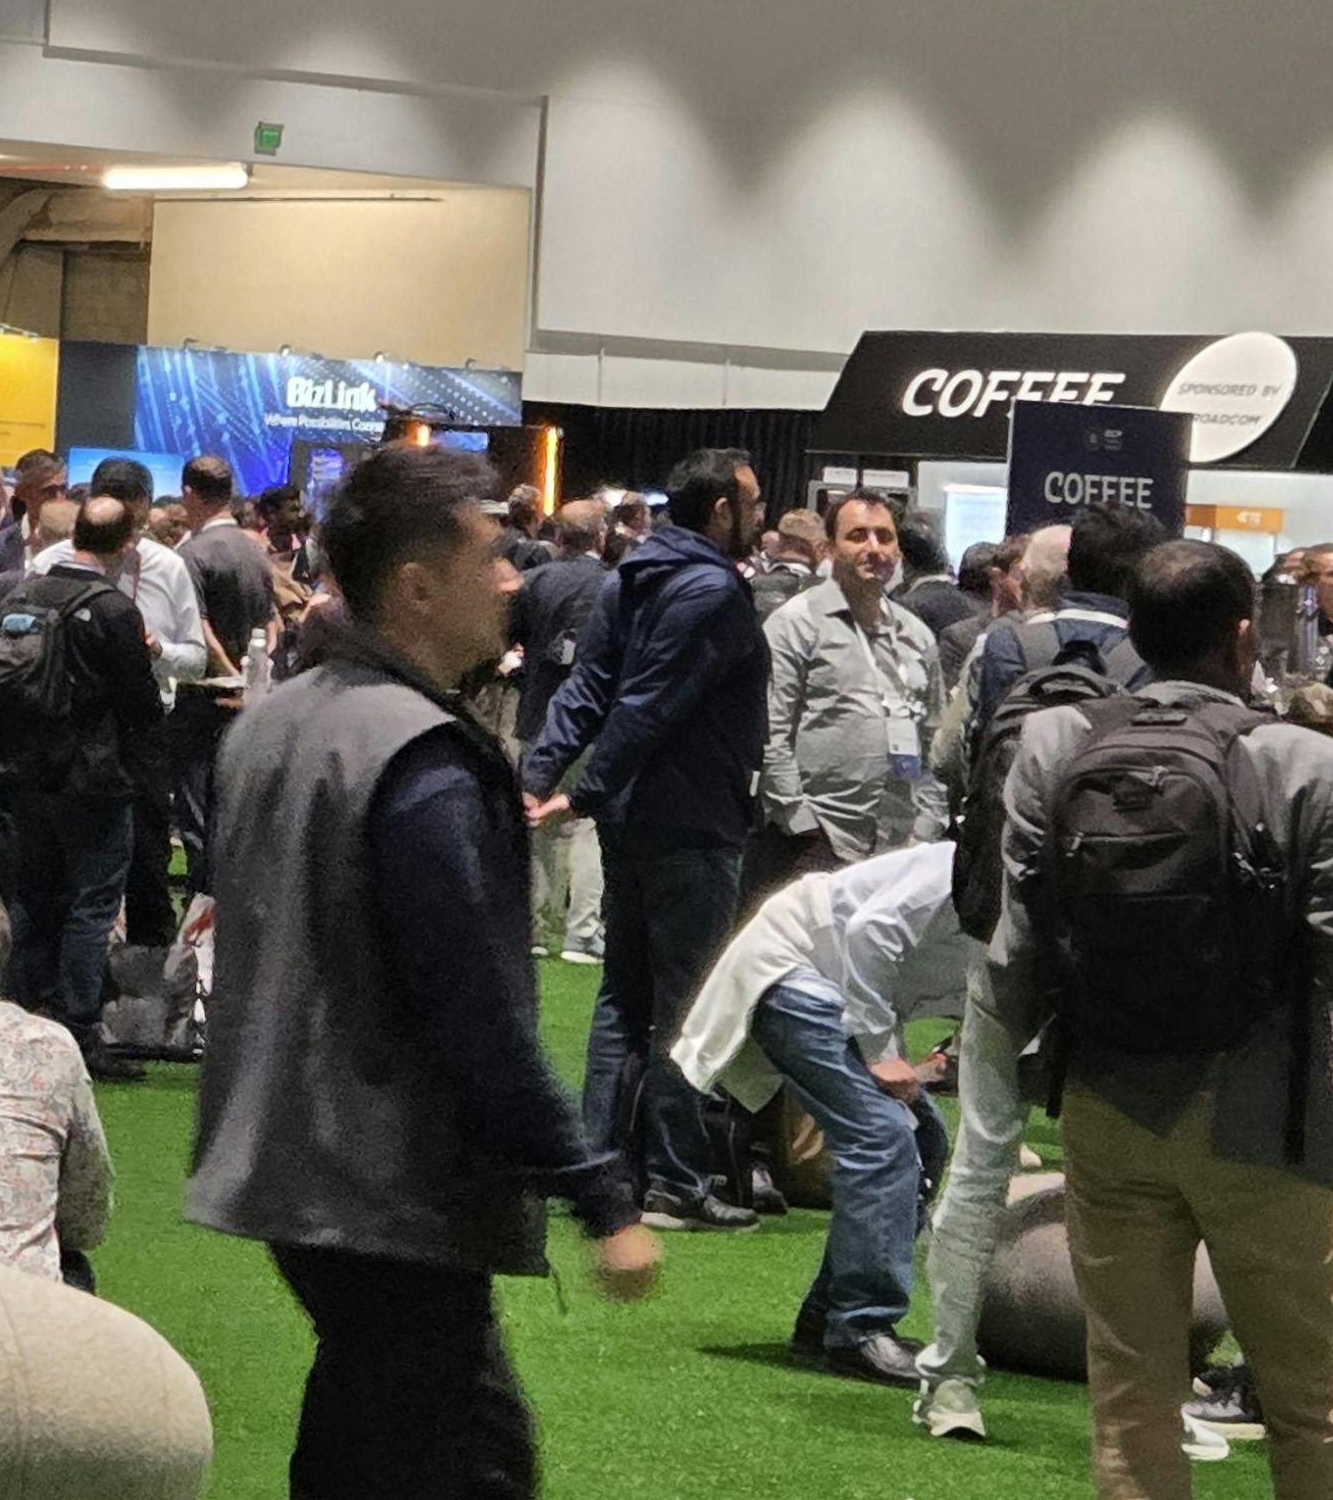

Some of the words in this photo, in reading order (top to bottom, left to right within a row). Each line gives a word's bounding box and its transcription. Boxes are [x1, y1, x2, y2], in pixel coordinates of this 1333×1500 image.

[286, 377, 377, 412] BizLink
[1177, 383, 1257, 397] SPONSORED
[1262, 384, 1283, 397] BY
[1193, 413, 1261, 426] ROADCOM
[1044, 471, 1154, 508] COFFEE
